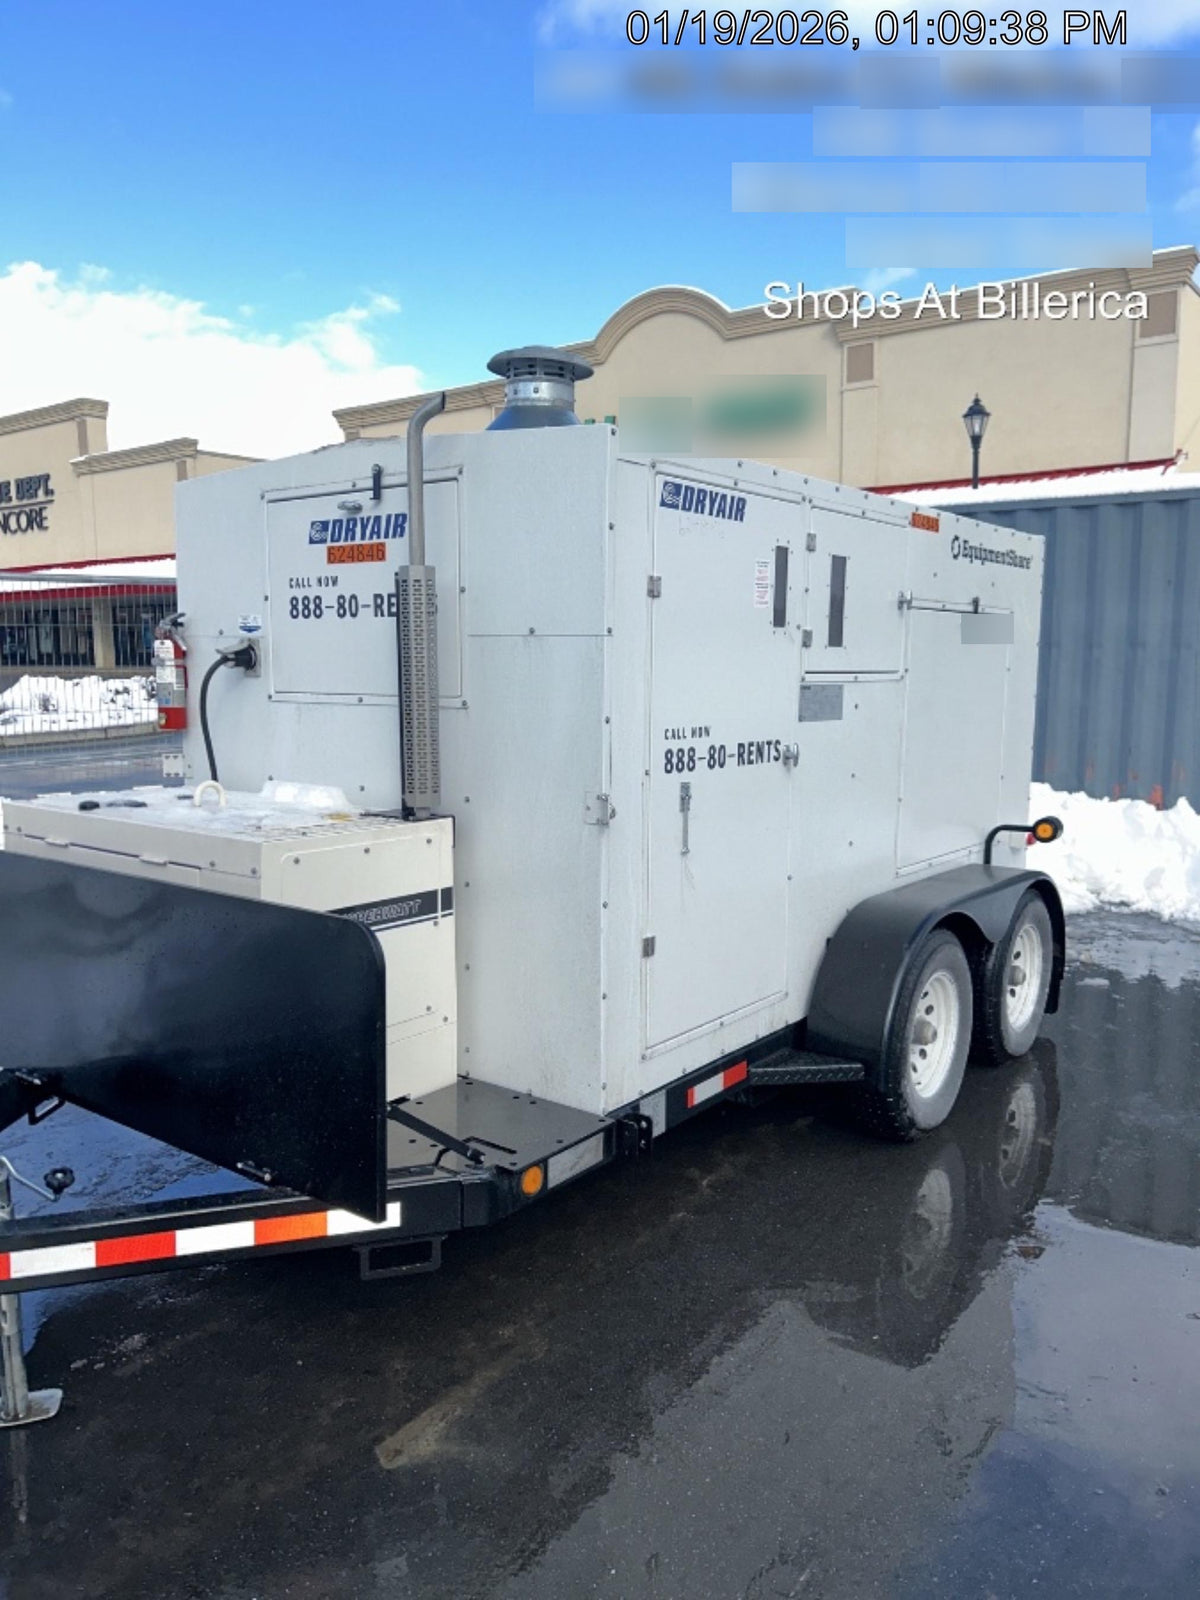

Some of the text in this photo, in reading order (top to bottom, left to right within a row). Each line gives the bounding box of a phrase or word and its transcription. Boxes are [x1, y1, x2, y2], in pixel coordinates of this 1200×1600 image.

[15, 473, 54, 500] DEPT.
[681, 484, 747, 522] DRYAIR
[329, 512, 408, 543] DRYAIR
[327, 543, 385, 563] 624846
[289, 575, 339, 589] CALL NOW
[289, 593, 398, 619] 888-80-RE
[664, 727, 687, 740] CALL
[664, 739, 781, 774] 888-80-RENTS
